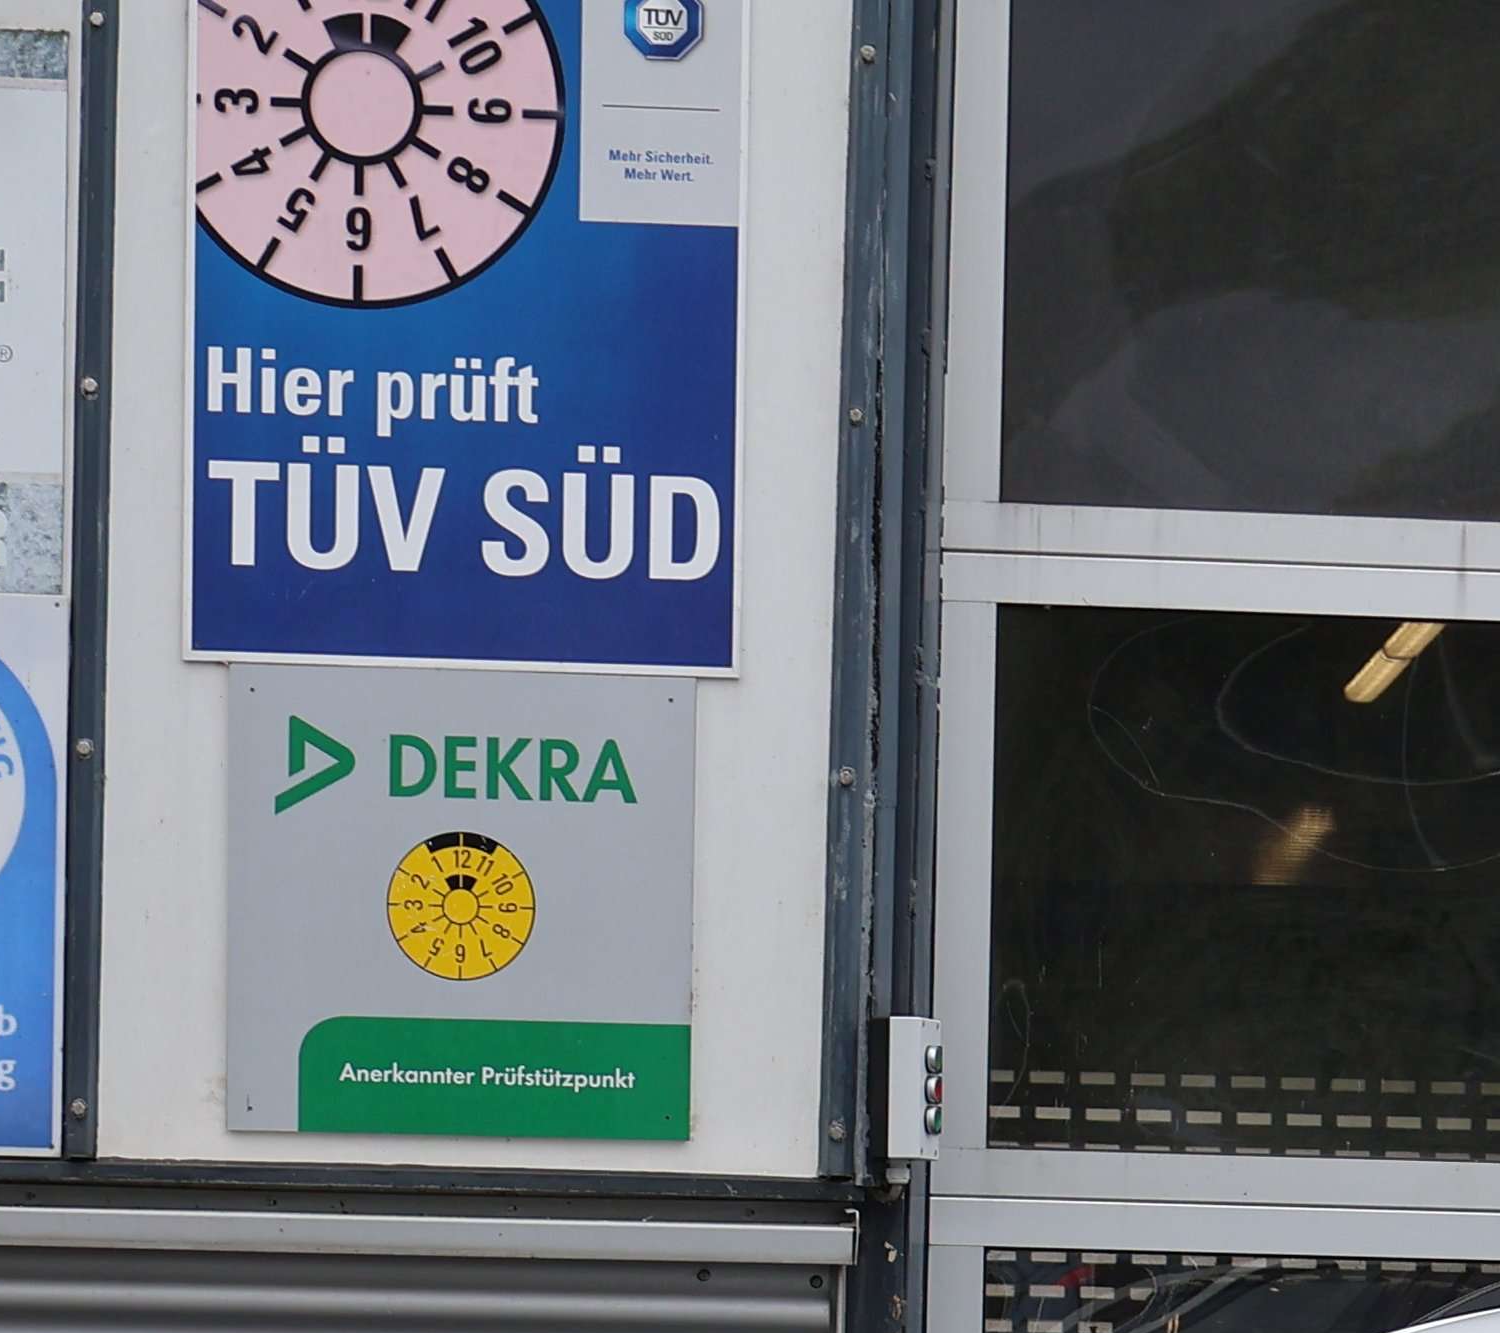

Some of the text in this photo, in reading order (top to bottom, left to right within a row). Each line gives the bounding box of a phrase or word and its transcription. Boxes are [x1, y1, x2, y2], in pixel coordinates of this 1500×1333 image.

[231, 14, 279, 55] 2
[446, 16, 502, 75] 10
[214, 87, 259, 114] 3
[467, 98, 512, 124] 9
[230, 147, 272, 177] 4
[609, 149, 714, 165] Mehr Sicherheit.
[447, 156, 491, 194] 8
[624, 167, 694, 182] Mehr Wert.
[276, 187, 316, 234] 5
[409, 195, 440, 242] 7
[207, 345, 540, 437] Hier prüft
[208, 436, 722, 582] TÜV SÜD
[388, 733, 638, 804] DEKRA
[452, 849, 472, 869] 12
[476, 855, 495, 876] 11
[410, 874, 431, 890] 2
[491, 873, 514, 896] 10
[404, 899, 424, 911] 3
[410, 922, 428, 934] 4
[492, 923, 511, 939] 8
[428, 938, 445, 957] 5
[480, 939, 493, 958] 7
[339, 1061, 636, 1093] Anerkannter Prüfstützpunkt
